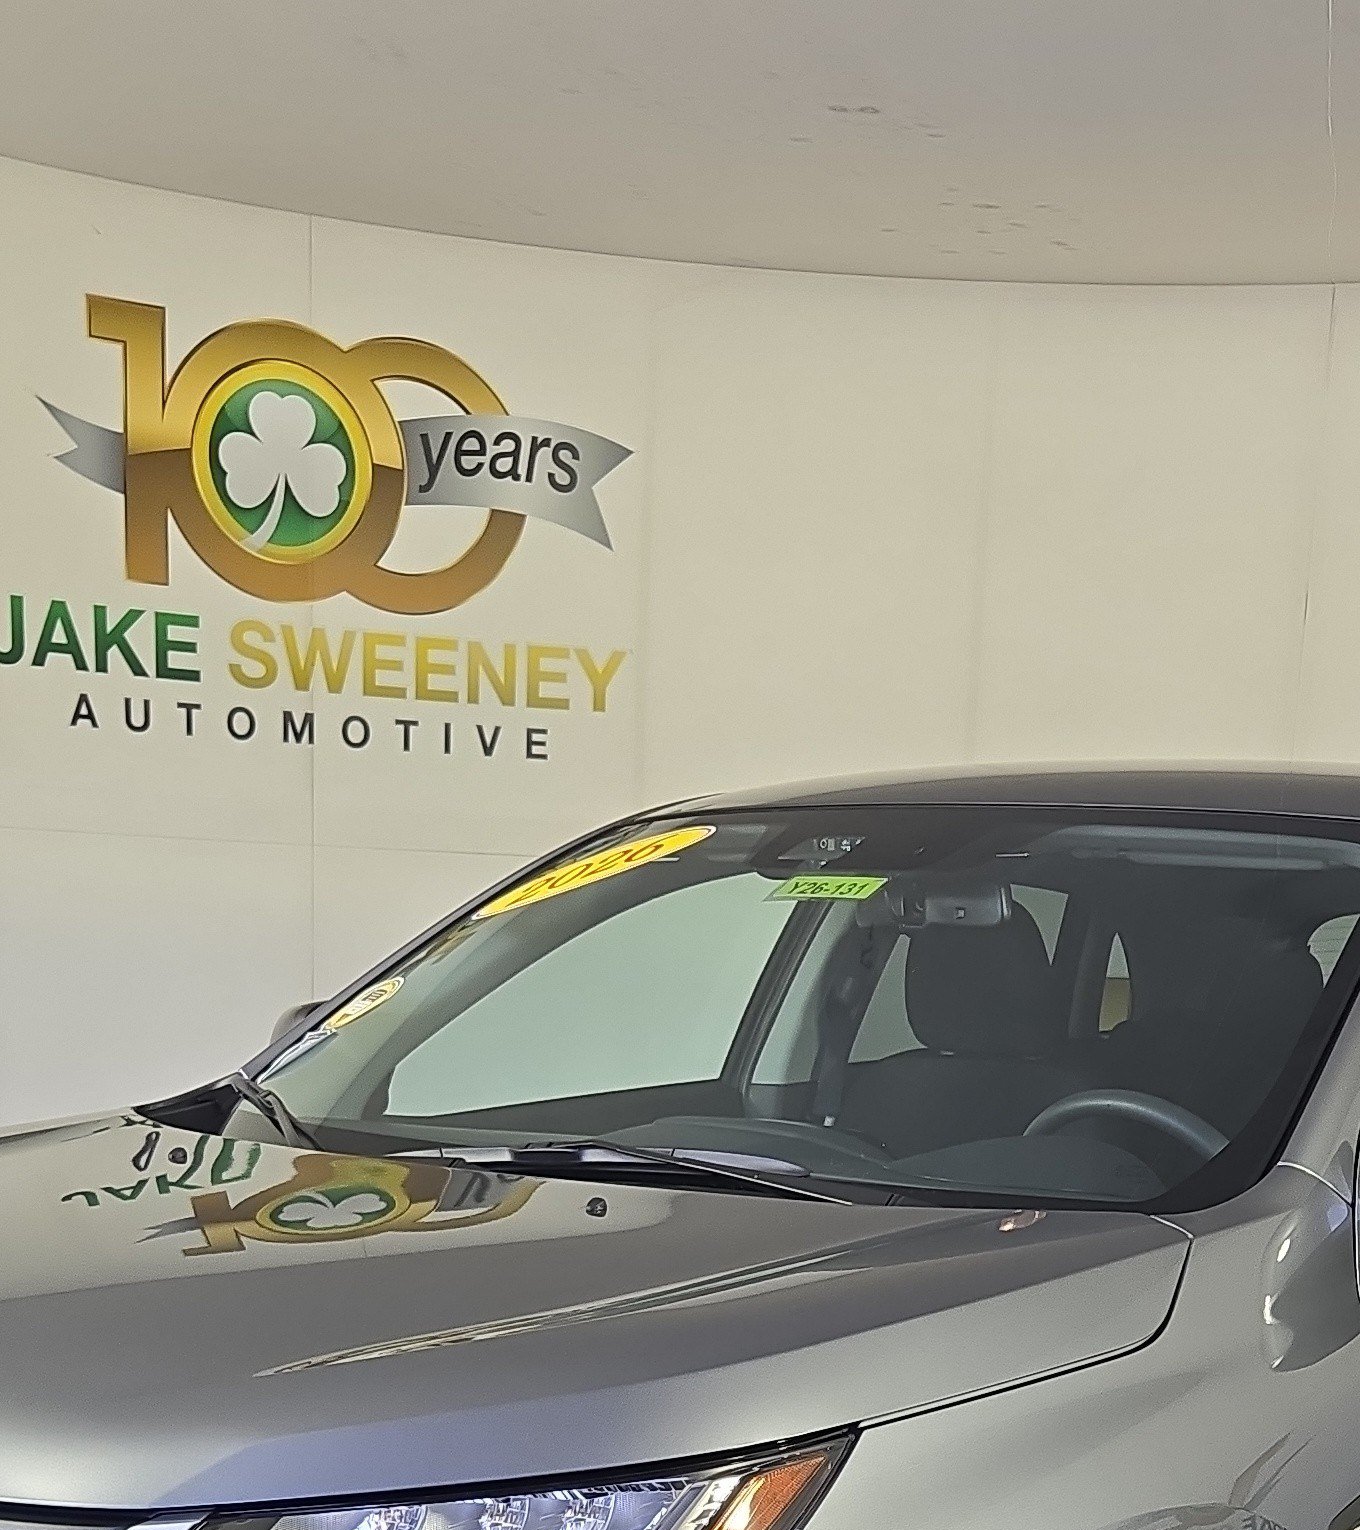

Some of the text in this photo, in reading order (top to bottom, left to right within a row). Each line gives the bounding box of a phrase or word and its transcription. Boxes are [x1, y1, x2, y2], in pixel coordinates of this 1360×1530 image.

[86, 293, 528, 616] 100
[418, 428, 581, 494] years
[228, 620, 627, 713] SWEENEY
[70, 693, 550, 761] AUTOMOTIVE
[505, 834, 677, 908] 2026
[788, 881, 870, 896] Y26-131
